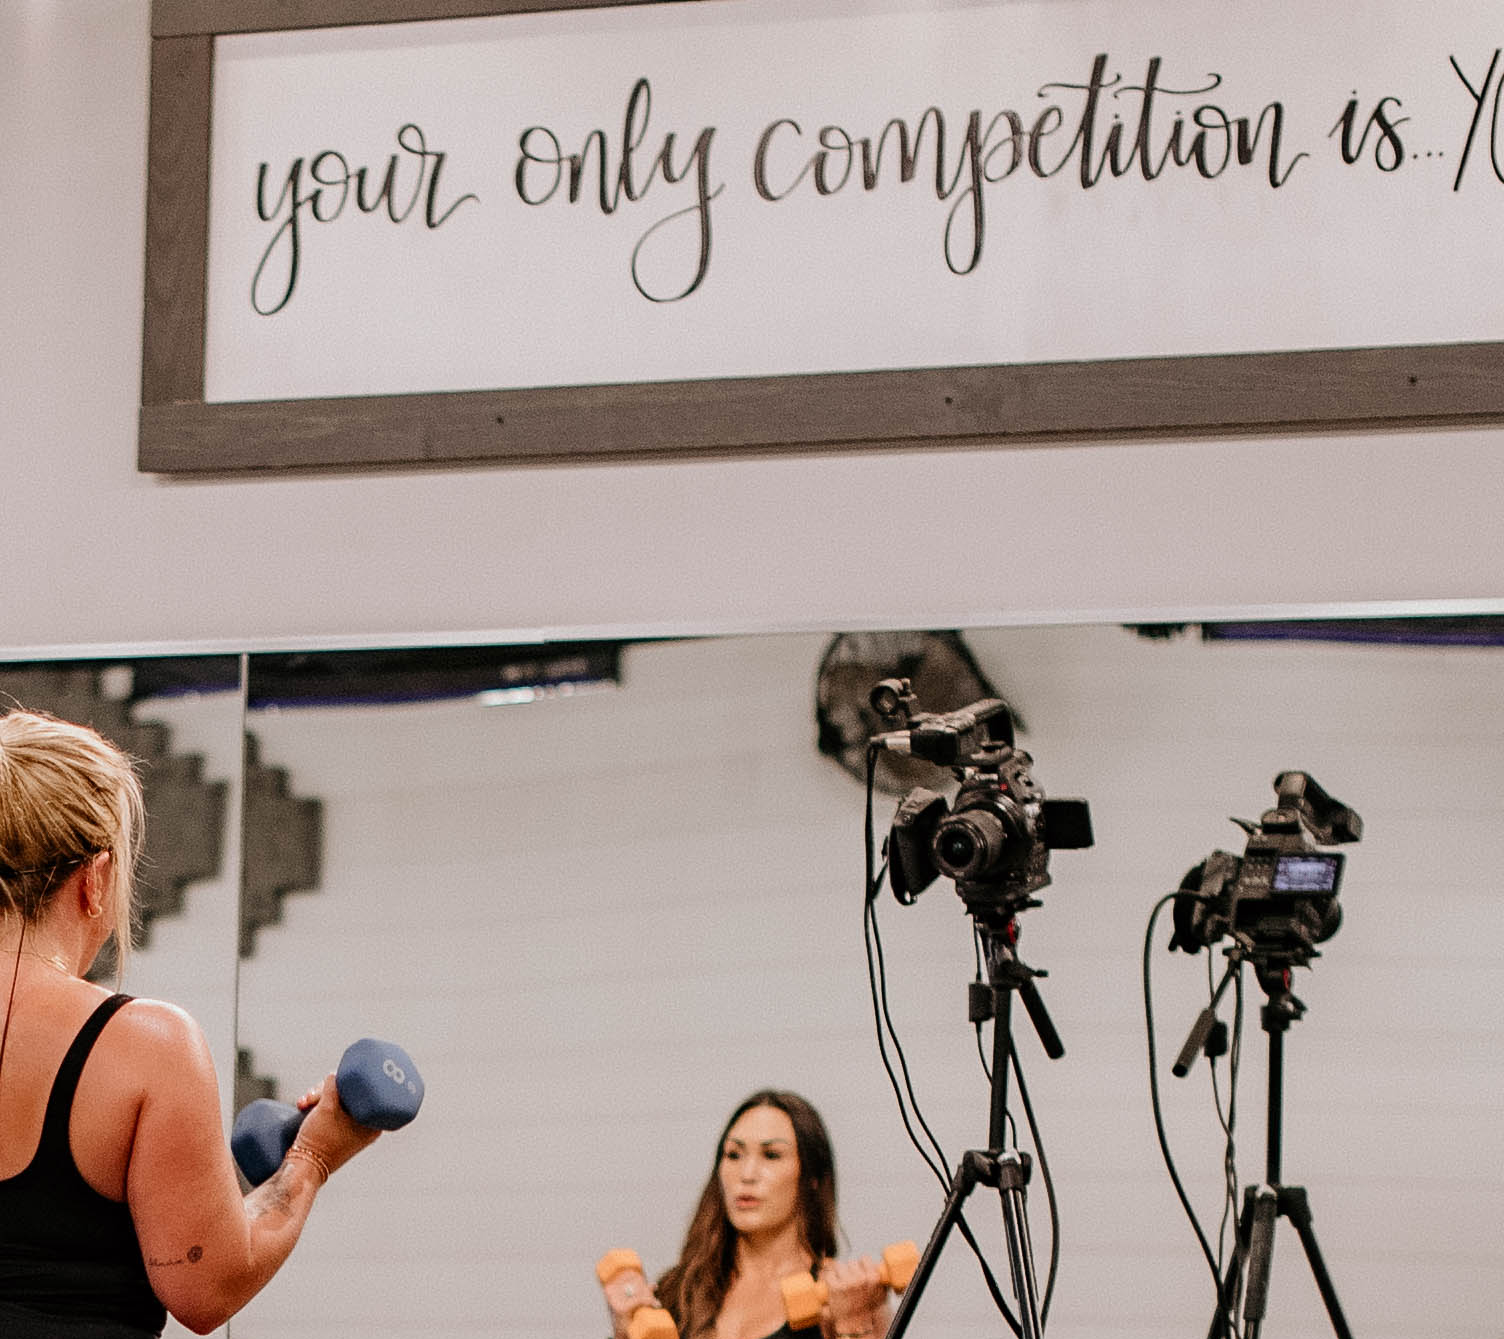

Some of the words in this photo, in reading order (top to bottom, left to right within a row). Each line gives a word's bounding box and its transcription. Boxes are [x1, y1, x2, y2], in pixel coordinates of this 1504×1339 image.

[252, 123, 480, 316] your
[515, 77, 726, 303] only
[754, 53, 1310, 276] competition
[383, 1059, 406, 1086] 8
